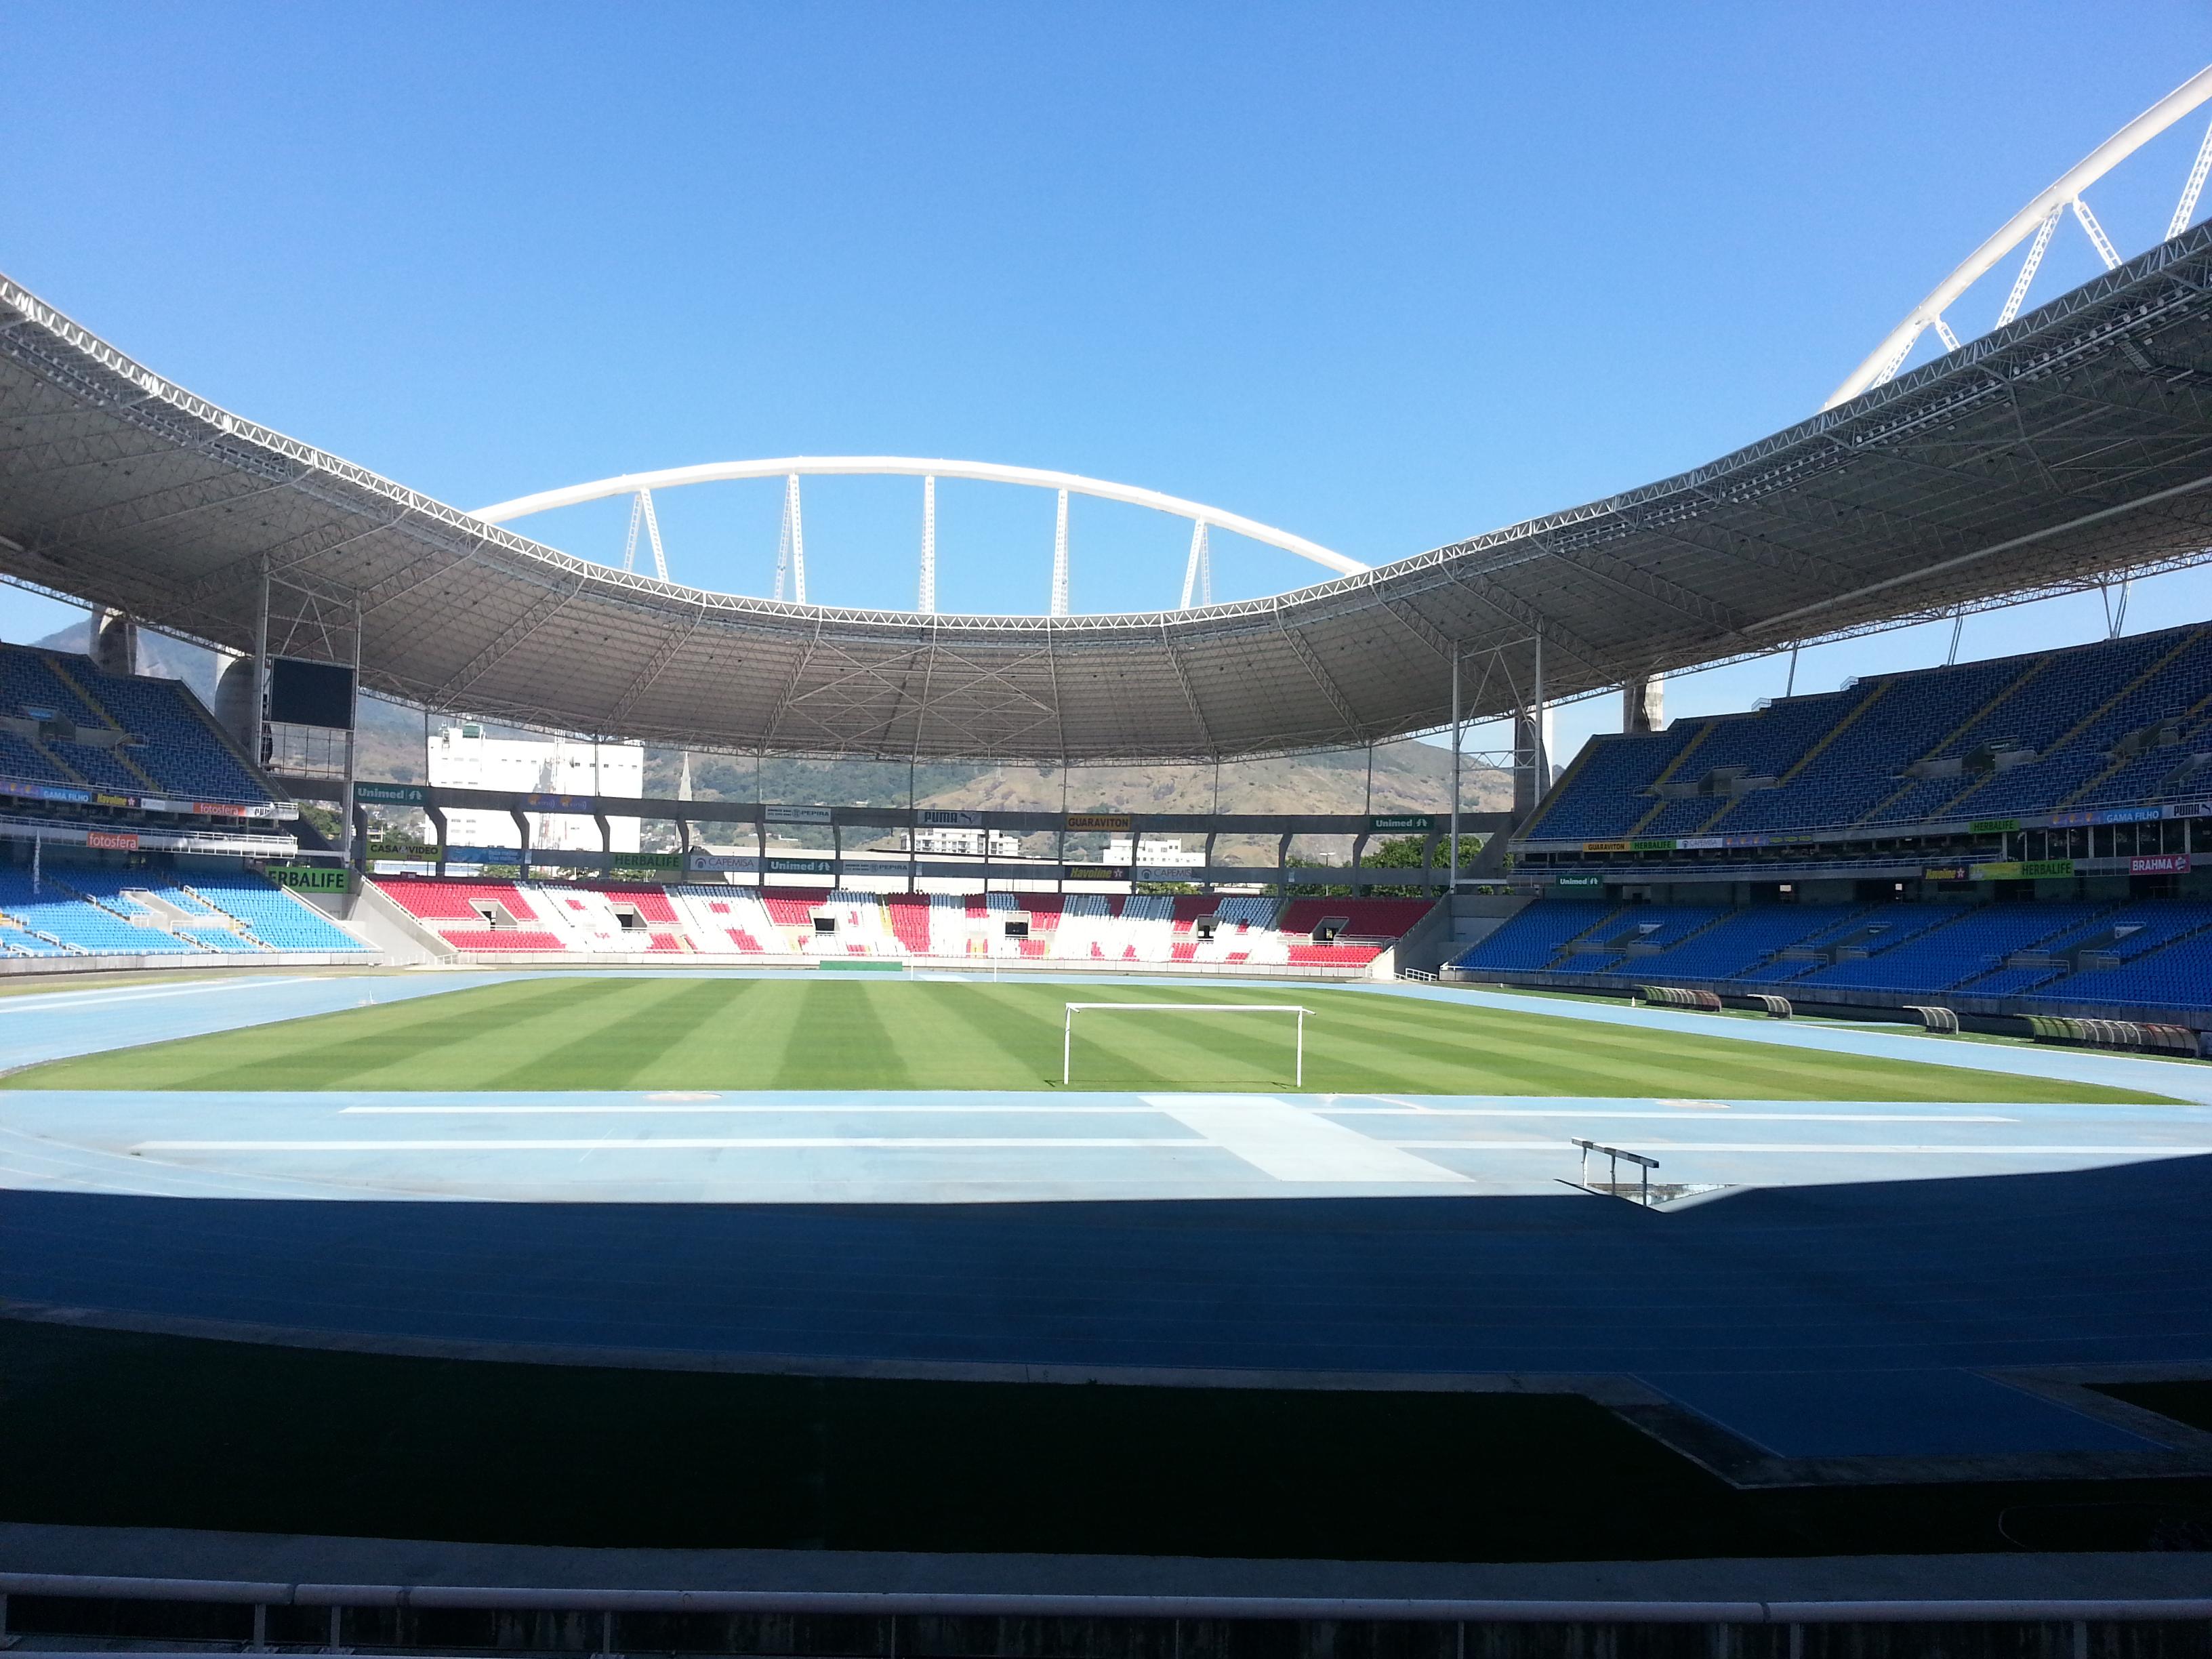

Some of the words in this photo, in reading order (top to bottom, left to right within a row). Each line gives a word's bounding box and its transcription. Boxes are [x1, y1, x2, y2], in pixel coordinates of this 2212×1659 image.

[43, 790, 66, 800] GAMA
[68, 792, 89, 802] FILHO
[357, 787, 404, 799] Unimed
[97, 794, 127, 805] Havoline
[201, 804, 238, 815] fotosfera
[2173, 804, 2200, 815] PUMA
[924, 812, 958, 823] PUMA
[1068, 817, 1128, 827] GUARAVITON
[2106, 813, 2133, 823] GAMA
[2135, 811, 2159, 820] FILHO
[1376, 819, 1412, 827] Unimed
[1973, 821, 2014, 831] HERBALIFE
[89, 834, 136, 848] fotosfera
[1634, 841, 1672, 850] HERBALIFE
[1588, 843, 1625, 851] GUARAVITON
[615, 855, 679, 867] HERBALIFE
[708, 857, 754, 867] CAPEMISA
[771, 860, 814, 872] Unimed
[2133, 859, 2173, 871] BRAHMA
[1070, 867, 1112, 879] Havoline
[1153, 868, 1191, 877] CAPEMIS
[2022, 863, 2071, 876] HERBALIFE
[268, 870, 344, 888] ERBALIFE
